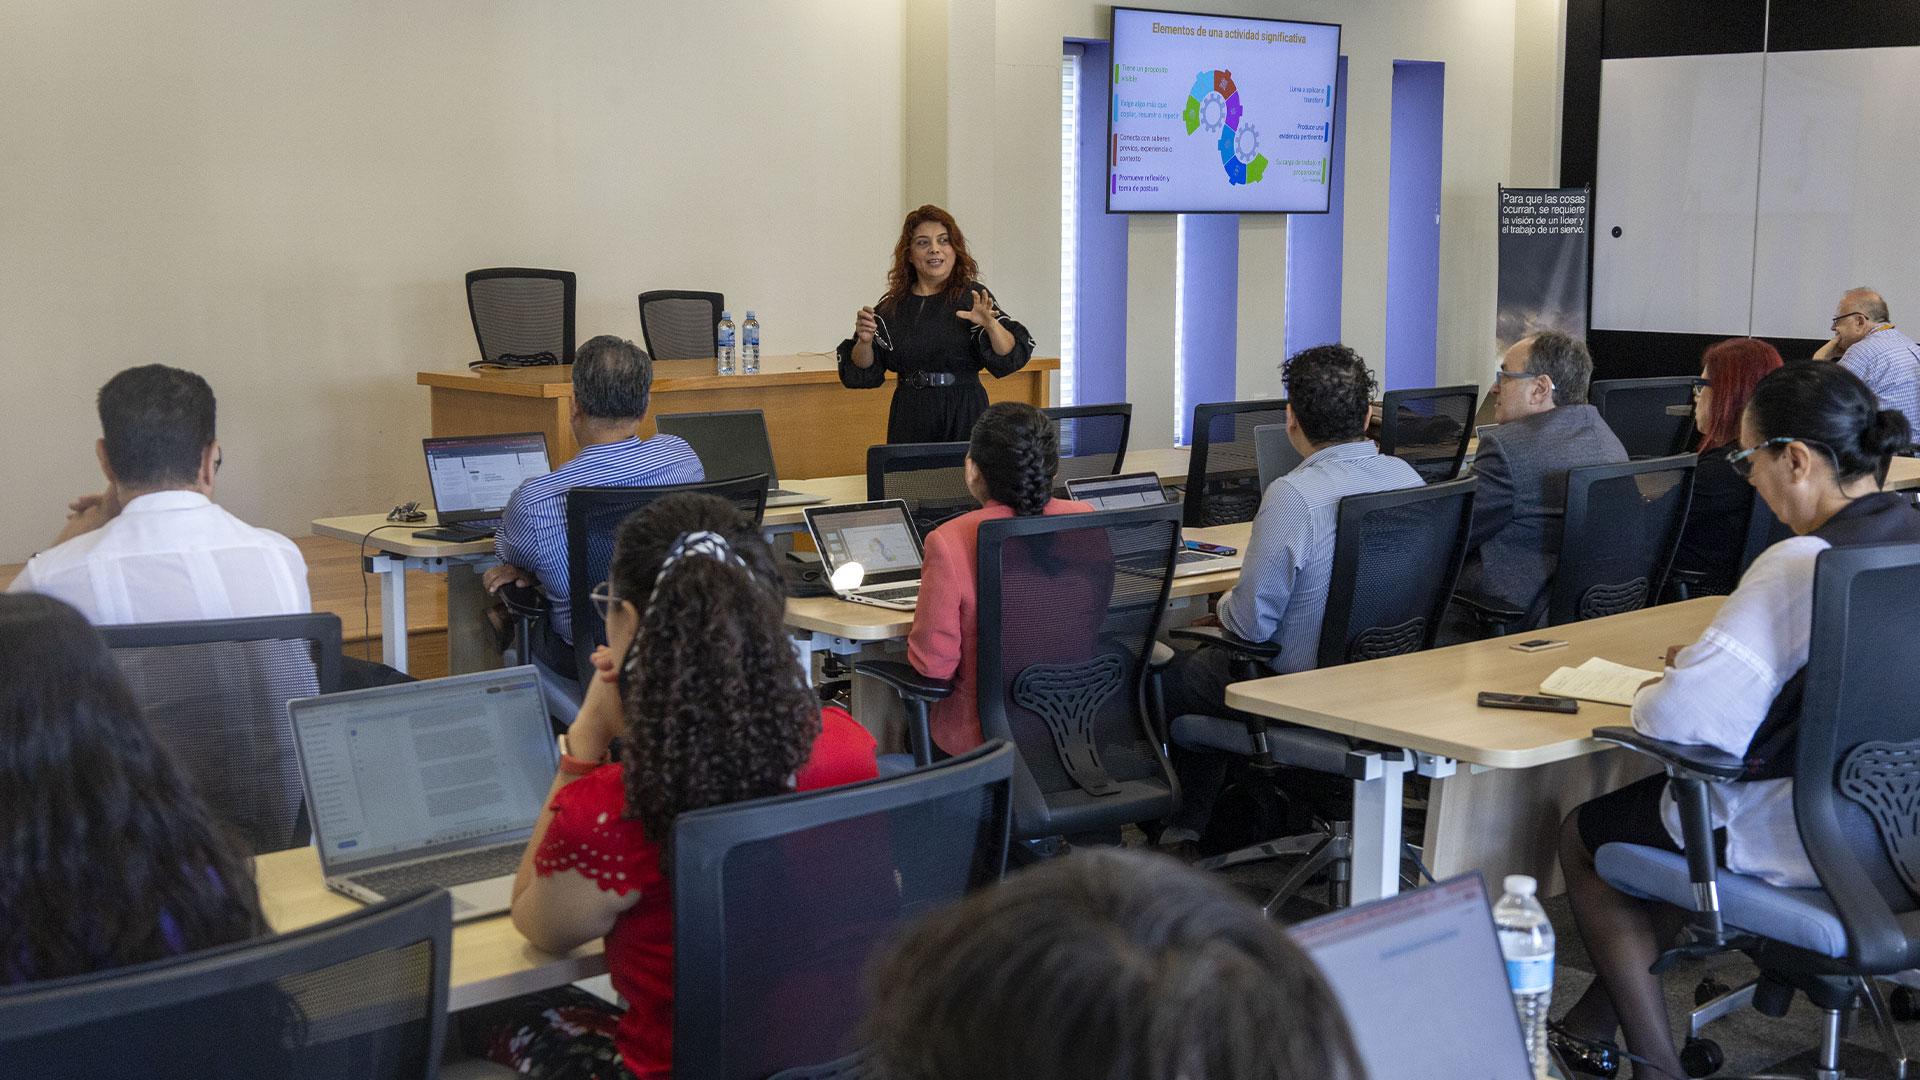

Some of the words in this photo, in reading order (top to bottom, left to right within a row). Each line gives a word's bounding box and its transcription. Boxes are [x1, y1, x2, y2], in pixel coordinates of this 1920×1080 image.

[1152, 22, 1194, 36] Elementos
[1196, 26, 1207, 37] de
[1208, 28, 1223, 38] una
[1224, 29, 1260, 41] actividad
[1261, 31, 1307, 44] significativa
[1119, 174, 1144, 182] Promueve
[1119, 184, 1132, 192] toma
[1502, 193, 1524, 204] Para
[1525, 196, 1543, 206] que
[1544, 194, 1558, 204] las
[1559, 195, 1586, 204] cosas
[1502, 206, 1537, 215] ocurran,
[1551, 205, 1586, 216] requiere
[1502, 216, 1510, 225] la
[1511, 216, 1534, 225] visión
[1535, 216, 1547, 225] de
[1548, 217, 1559, 225] un
[1579, 217, 1585, 226] y
[1501, 226, 1509, 234] el
[1510, 225, 1536, 236] trabajo
[1537, 226, 1548, 234] de
[1549, 226, 1559, 234] un
[1560, 225, 1585, 234] siervo.
